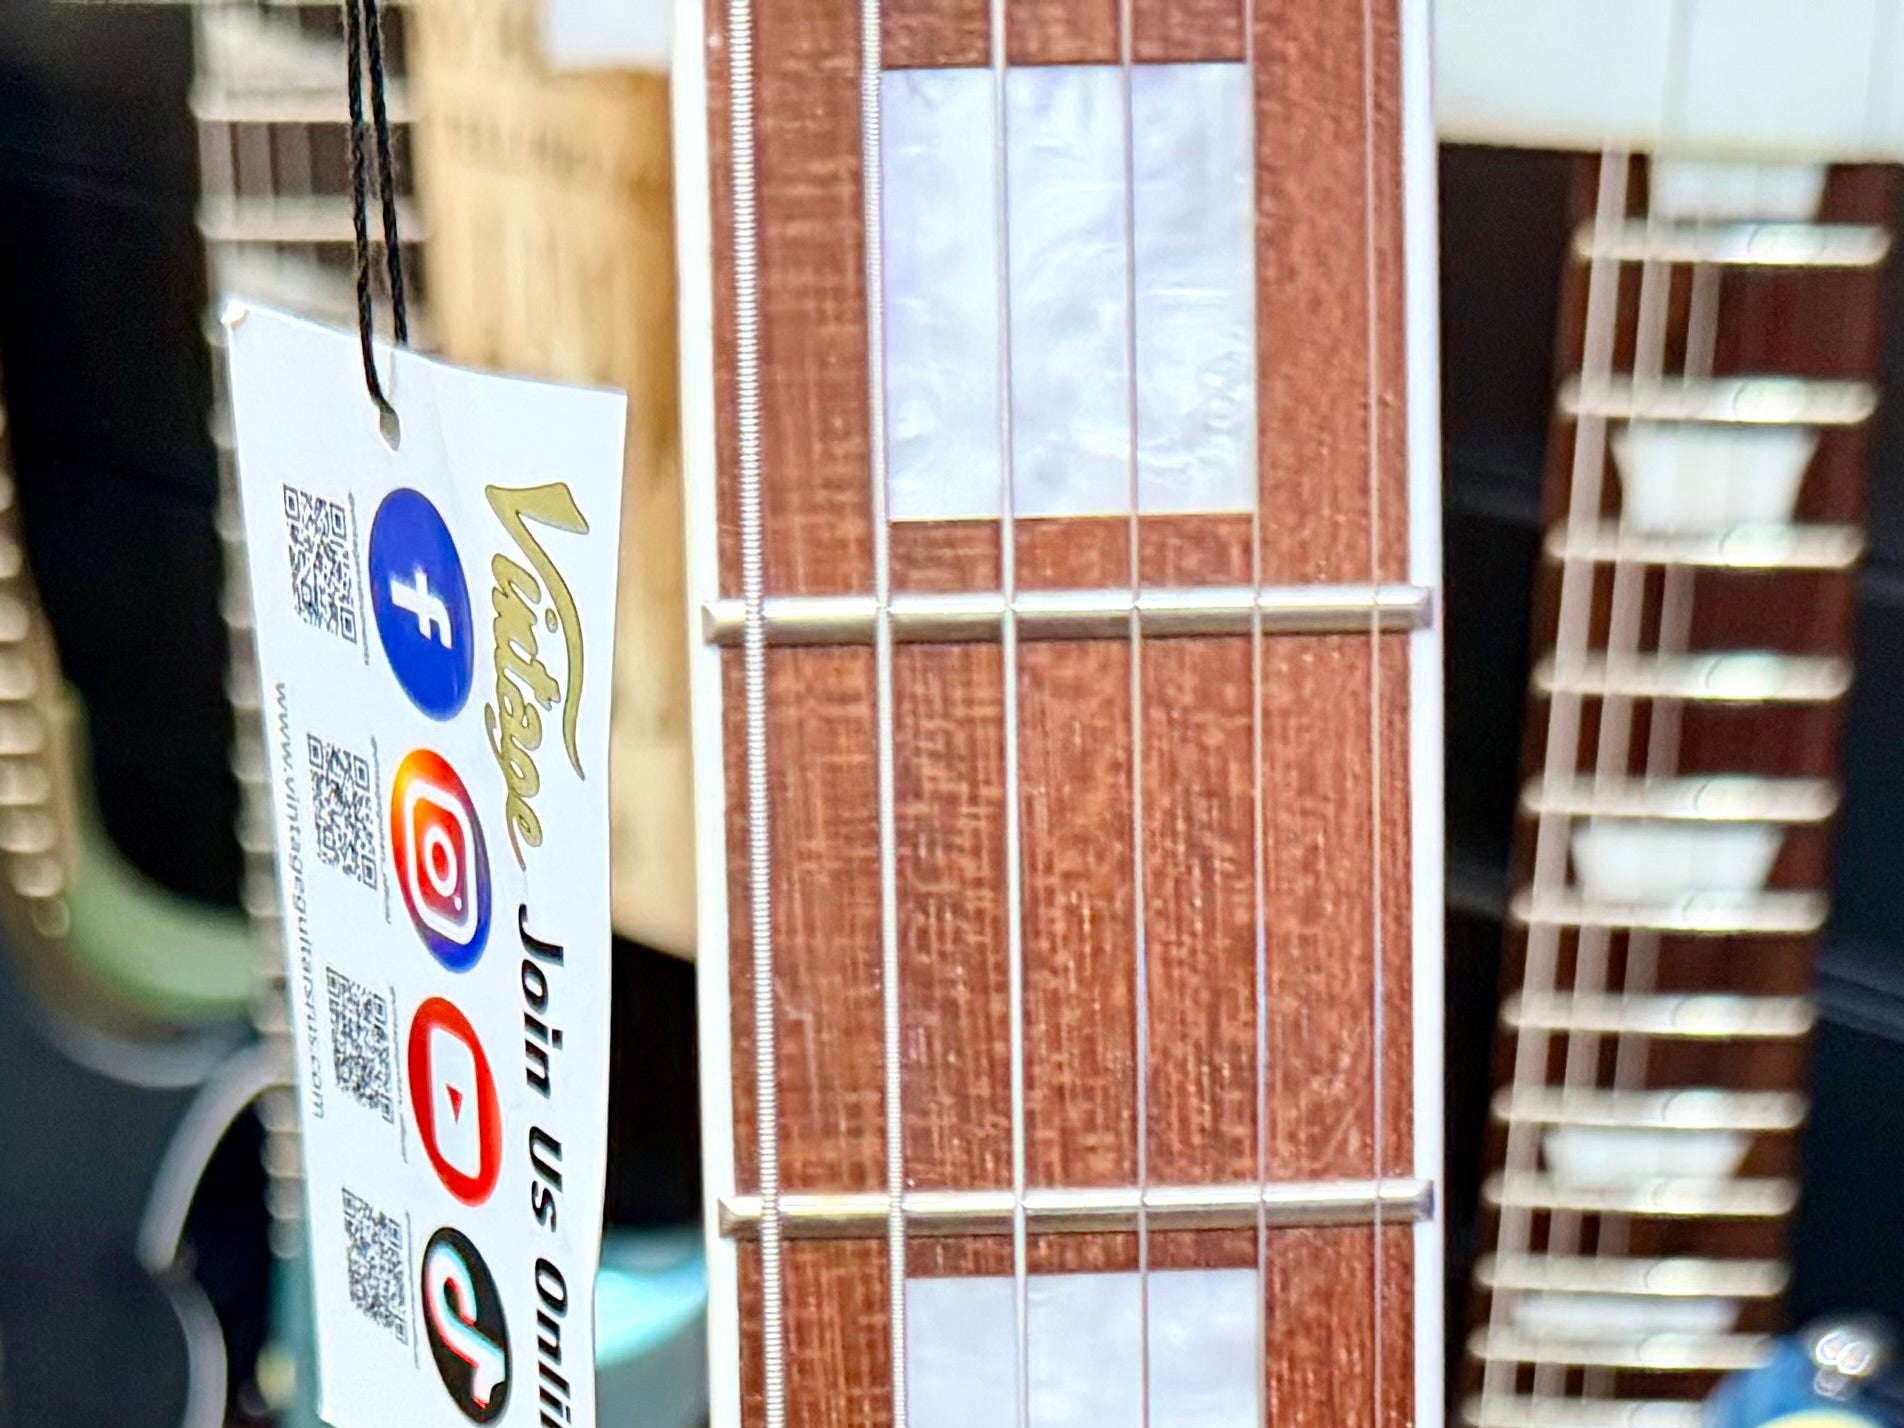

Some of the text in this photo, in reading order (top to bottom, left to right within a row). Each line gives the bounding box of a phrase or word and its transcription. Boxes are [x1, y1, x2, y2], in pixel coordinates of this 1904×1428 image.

[485, 482, 589, 870] Vintage
[275, 682, 325, 1119] www.vintageguitarsrus.com
[518, 903, 564, 1099] Join
